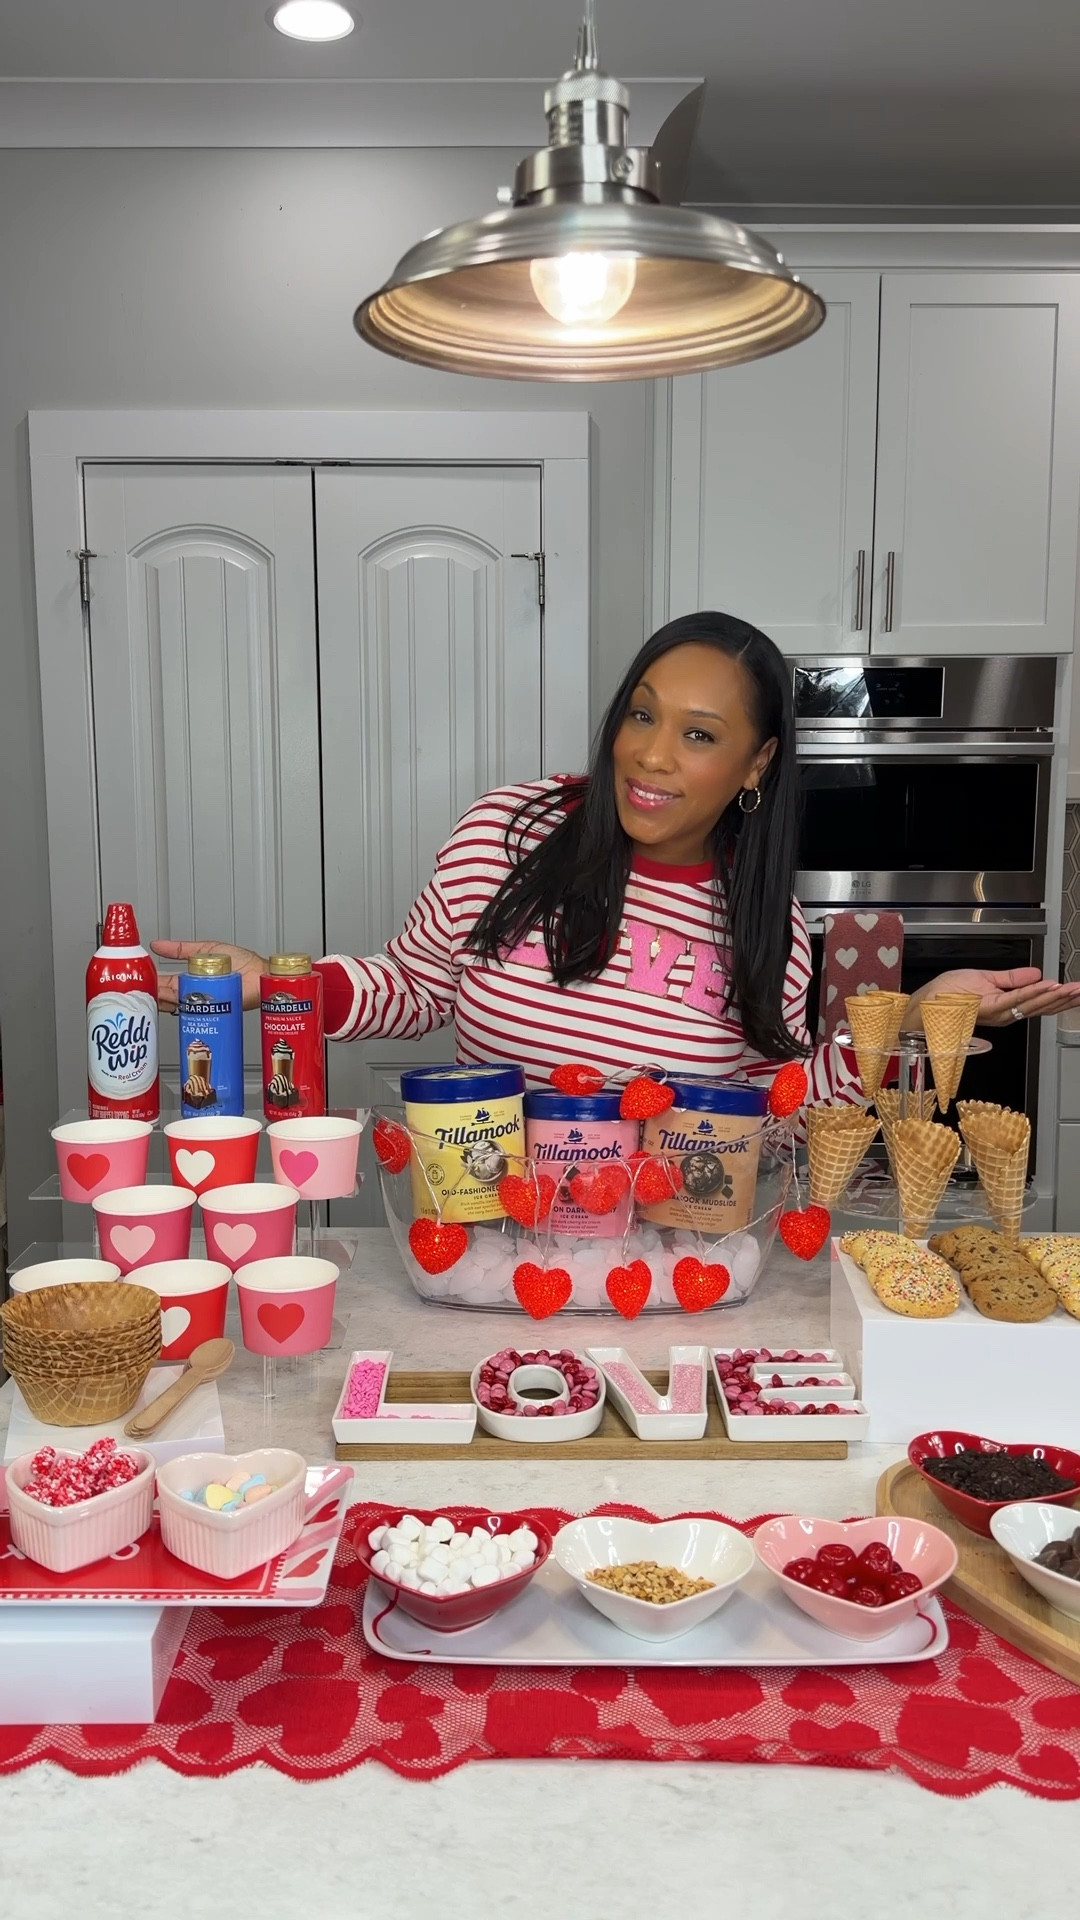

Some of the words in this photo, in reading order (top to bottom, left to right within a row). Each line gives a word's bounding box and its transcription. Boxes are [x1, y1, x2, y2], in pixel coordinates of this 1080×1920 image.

[99, 973, 143, 983] ORIGINAL
[261, 1002, 311, 1012] GHIRARDELLI
[181, 1025, 219, 1035] CARAMEL
[263, 1022, 306, 1031] CHOCOLATE
[92, 1015, 150, 1061] Reddi
[435, 1114, 521, 1150] Tillamook
[658, 1129, 750, 1154] Tillamook
[533, 1140, 623, 1165] Tillamook
[701, 1199, 737, 1207] MUDSLIDE
